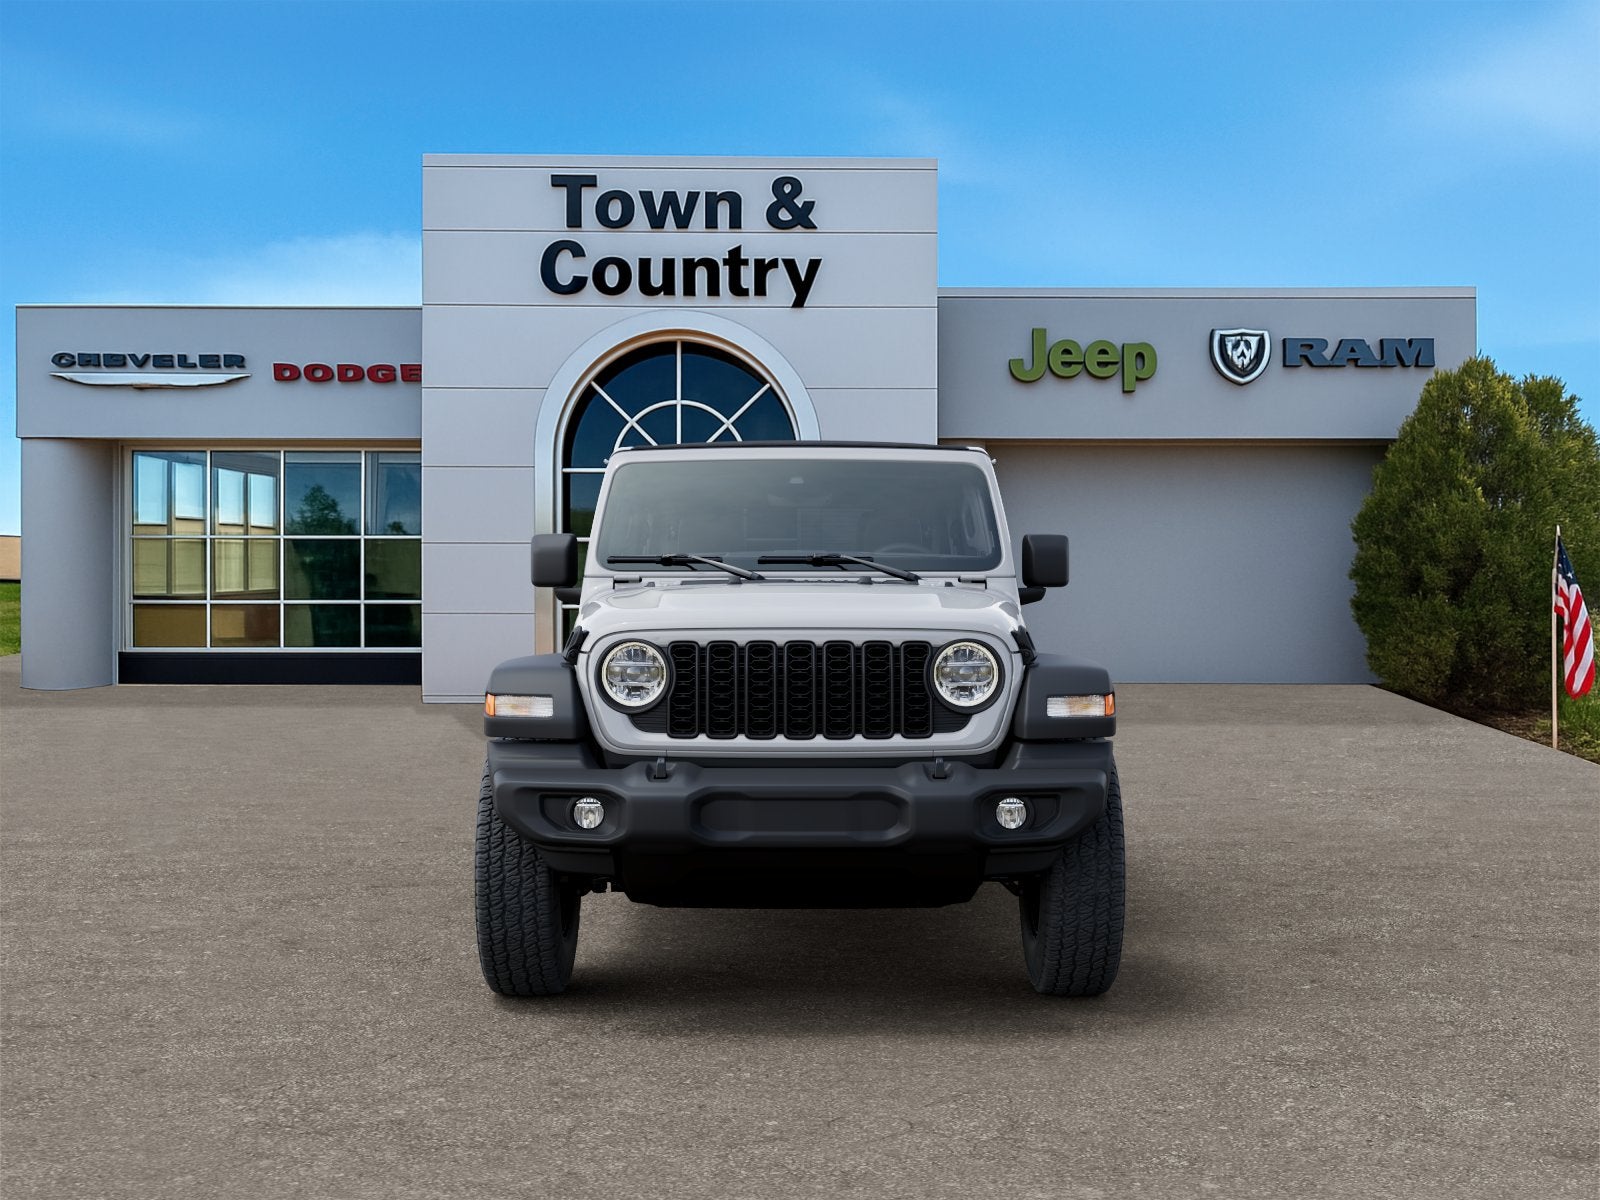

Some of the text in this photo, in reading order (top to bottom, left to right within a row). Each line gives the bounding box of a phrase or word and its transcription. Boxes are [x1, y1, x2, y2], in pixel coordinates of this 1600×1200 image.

[551, 174, 818, 230] Town &
[540, 239, 822, 308] Country
[273, 363, 422, 383] DODGE
[1009, 328, 1157, 393] Jeep
[1282, 337, 1435, 367] RAM
